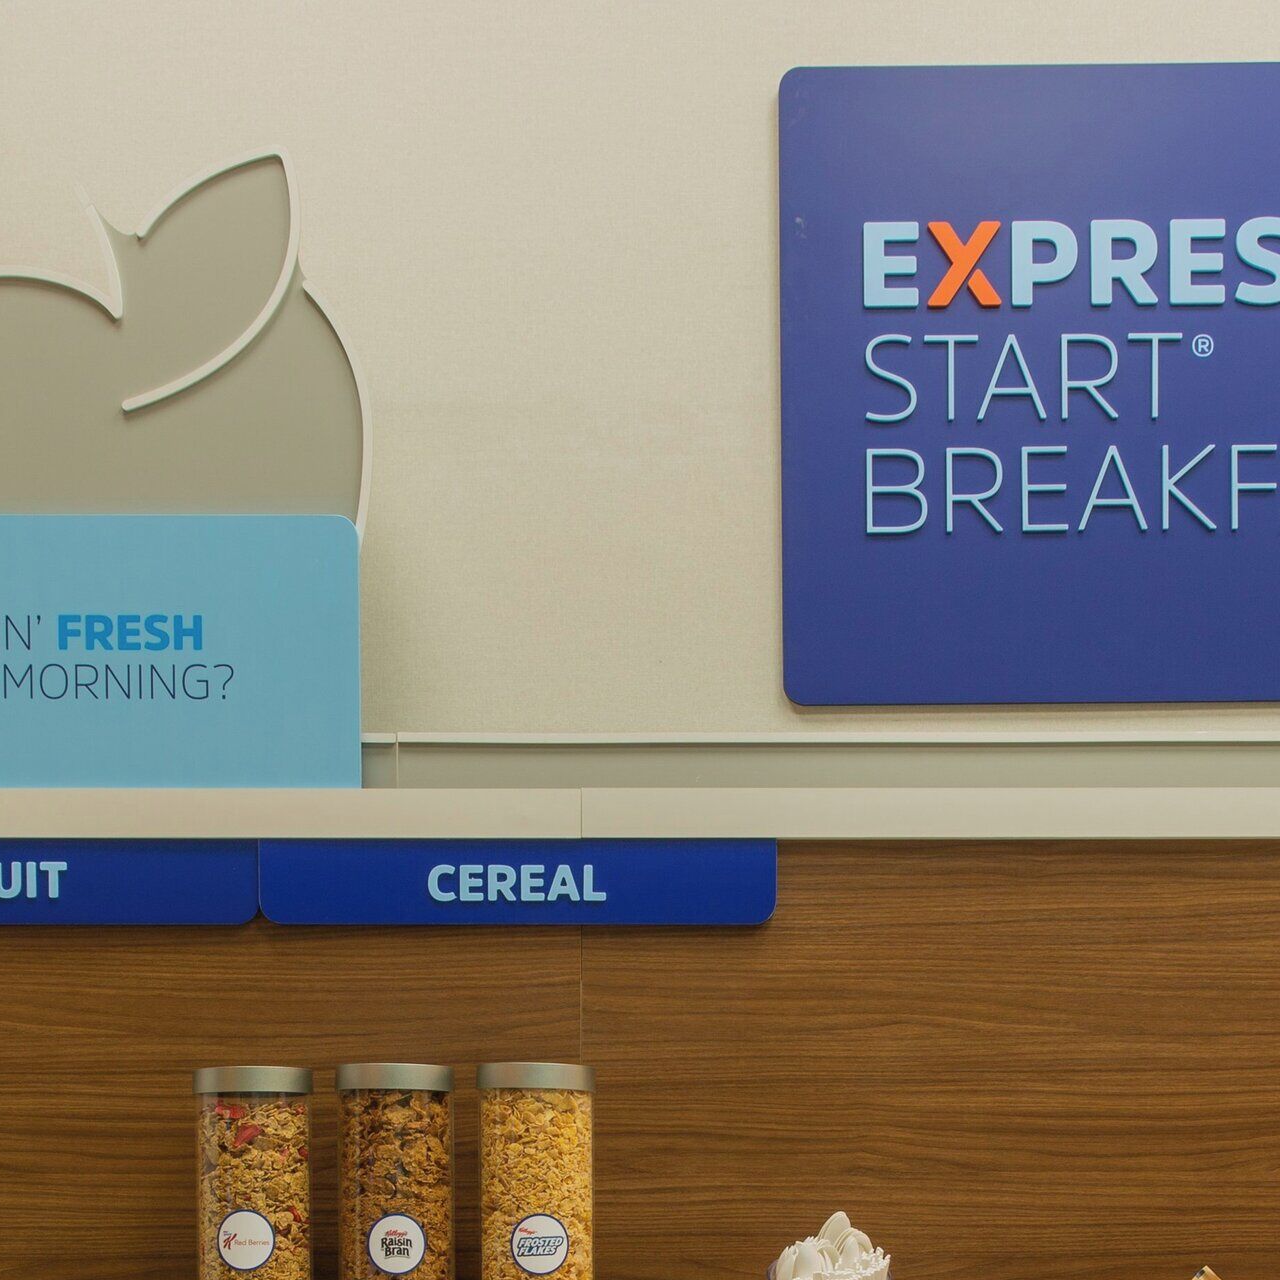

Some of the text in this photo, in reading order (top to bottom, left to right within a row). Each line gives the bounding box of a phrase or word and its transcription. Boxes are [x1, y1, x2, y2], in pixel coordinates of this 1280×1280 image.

[57, 613, 204, 651] FRESH
[2, 663, 236, 700] MORNING?
[426, 863, 608, 904] CEREAL
[381, 1237, 413, 1248] Raisin
[518, 1236, 564, 1248] FROSTED
[384, 1246, 410, 1257] Bran
[517, 1245, 557, 1257] FLAKES
